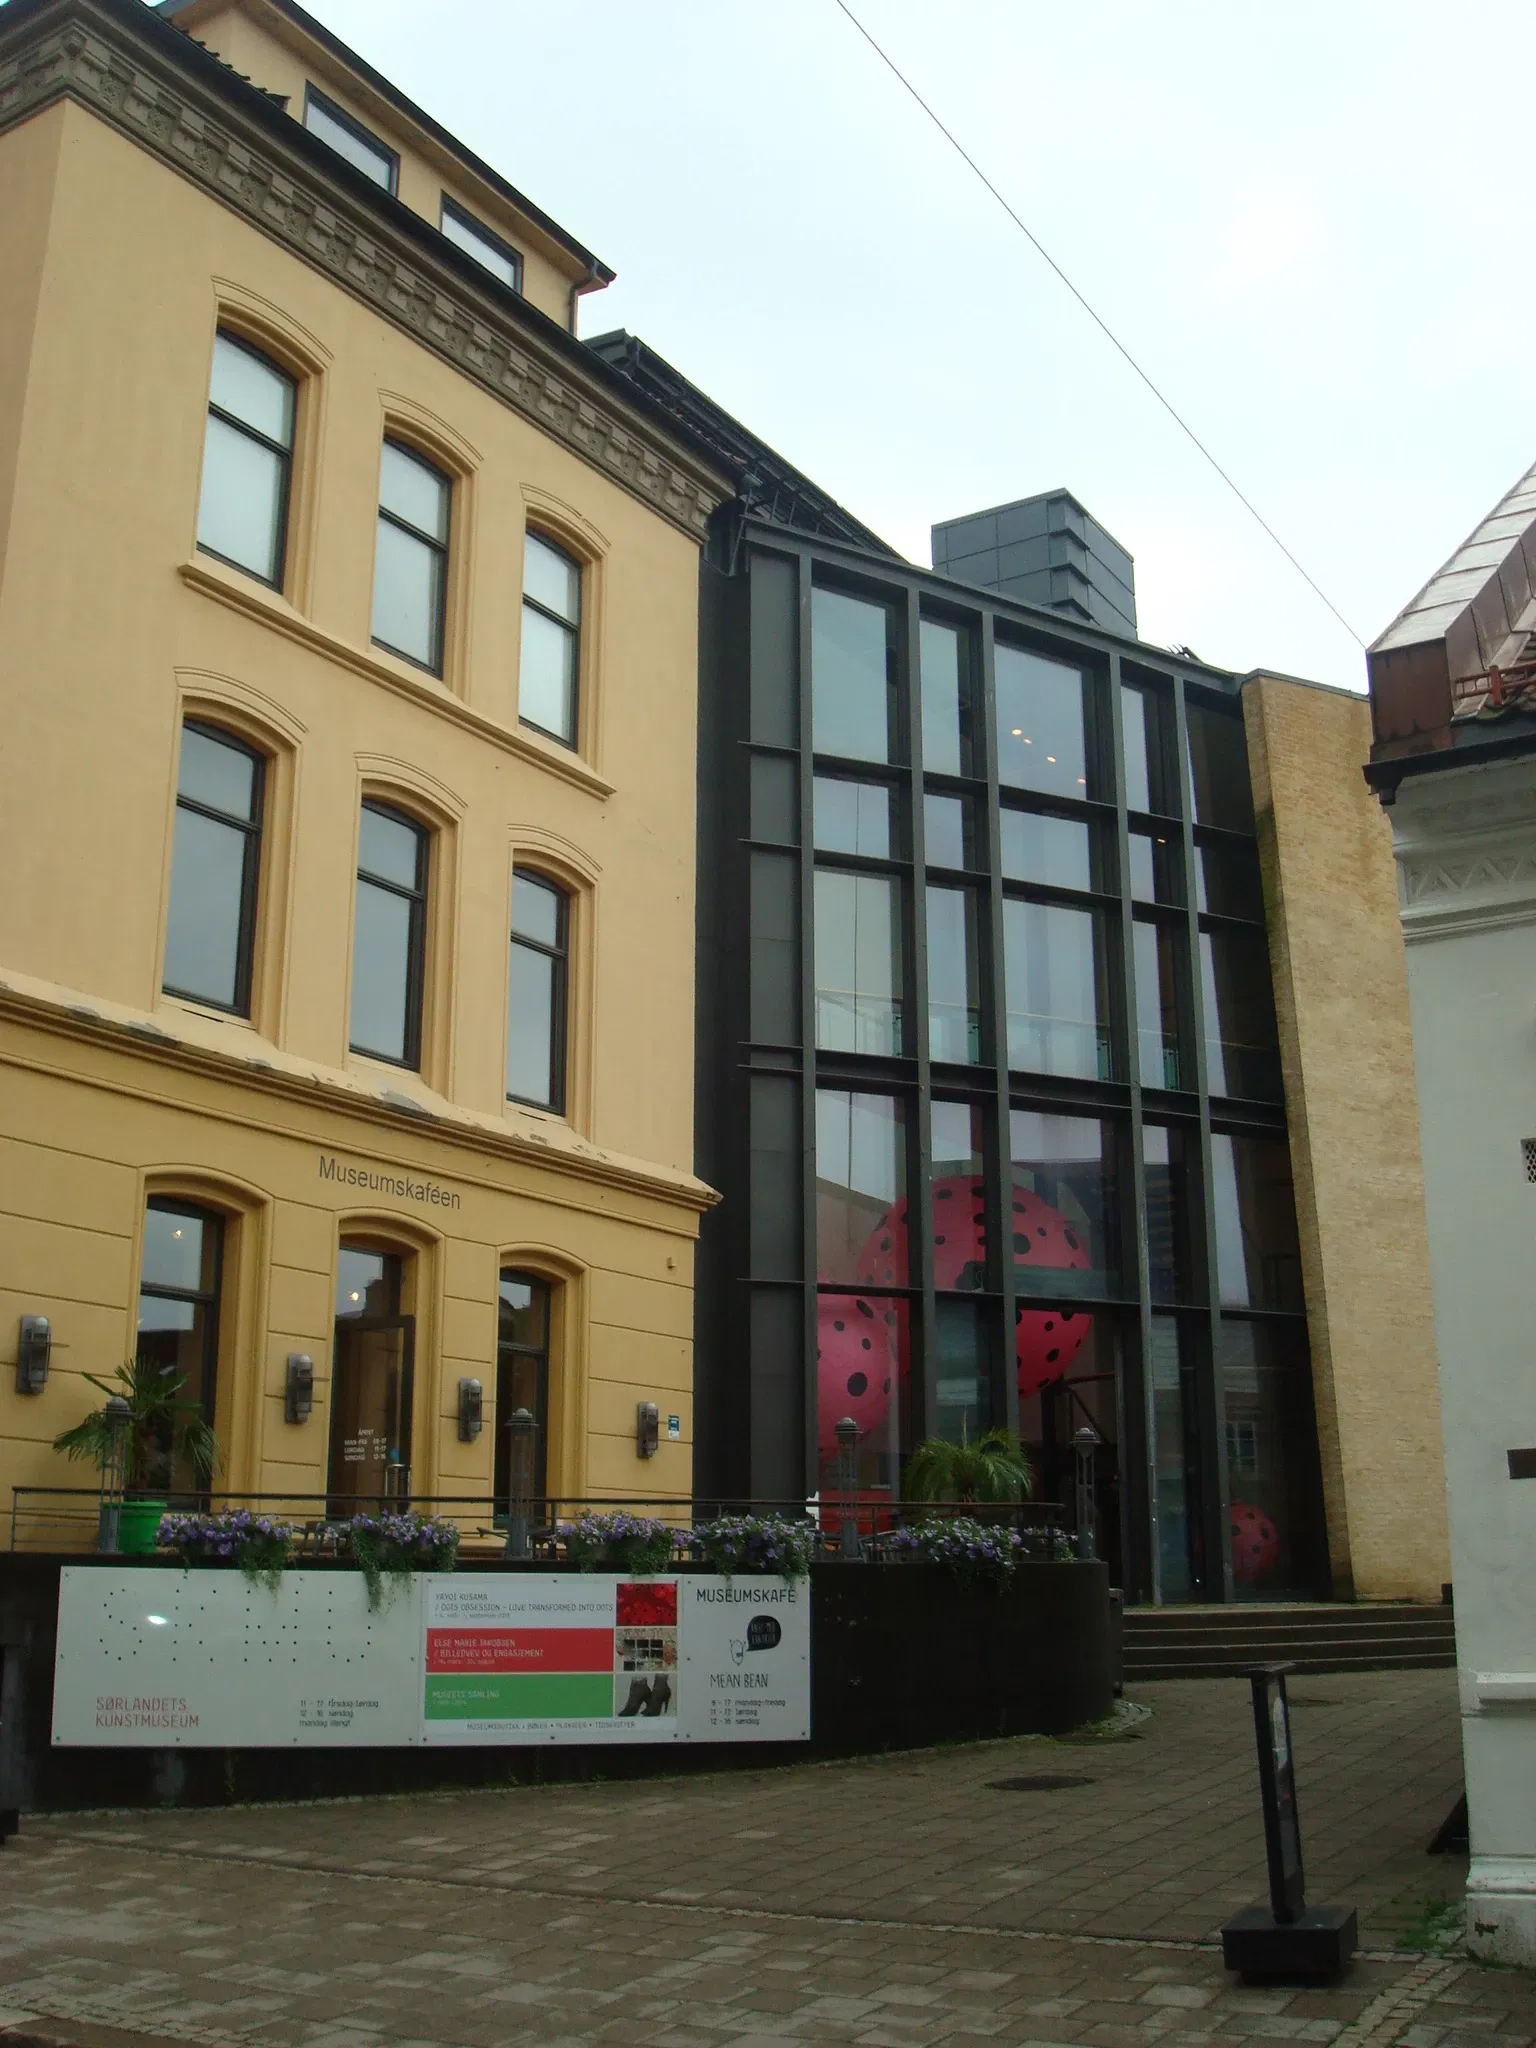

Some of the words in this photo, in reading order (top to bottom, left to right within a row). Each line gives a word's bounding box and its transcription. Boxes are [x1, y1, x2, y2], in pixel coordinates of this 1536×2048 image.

[318, 1155, 461, 1209] Museumskaféen
[435, 1592, 457, 1601] YAYOI
[459, 1592, 488, 1601] KUSAMA
[441, 1603, 459, 1611] DOTS
[460, 1603, 500, 1611] OBSESSION
[508, 1603, 526, 1611] LOVE
[528, 1603, 576, 1611] TRANSFORMED
[578, 1603, 595, 1611] INTO
[596, 1603, 613, 1611] DOTS
[434, 1638, 452, 1648] ELSE
[454, 1638, 477, 1648] MARIE
[493, 1648, 544, 1658] ENGASJEMENT
[710, 1672, 741, 1689] MEAN
[743, 1672, 769, 1689] BEAN
[95, 1695, 187, 1712] SØRLANDETS
[95, 1712, 200, 1729] KUNSTMUSEUM
